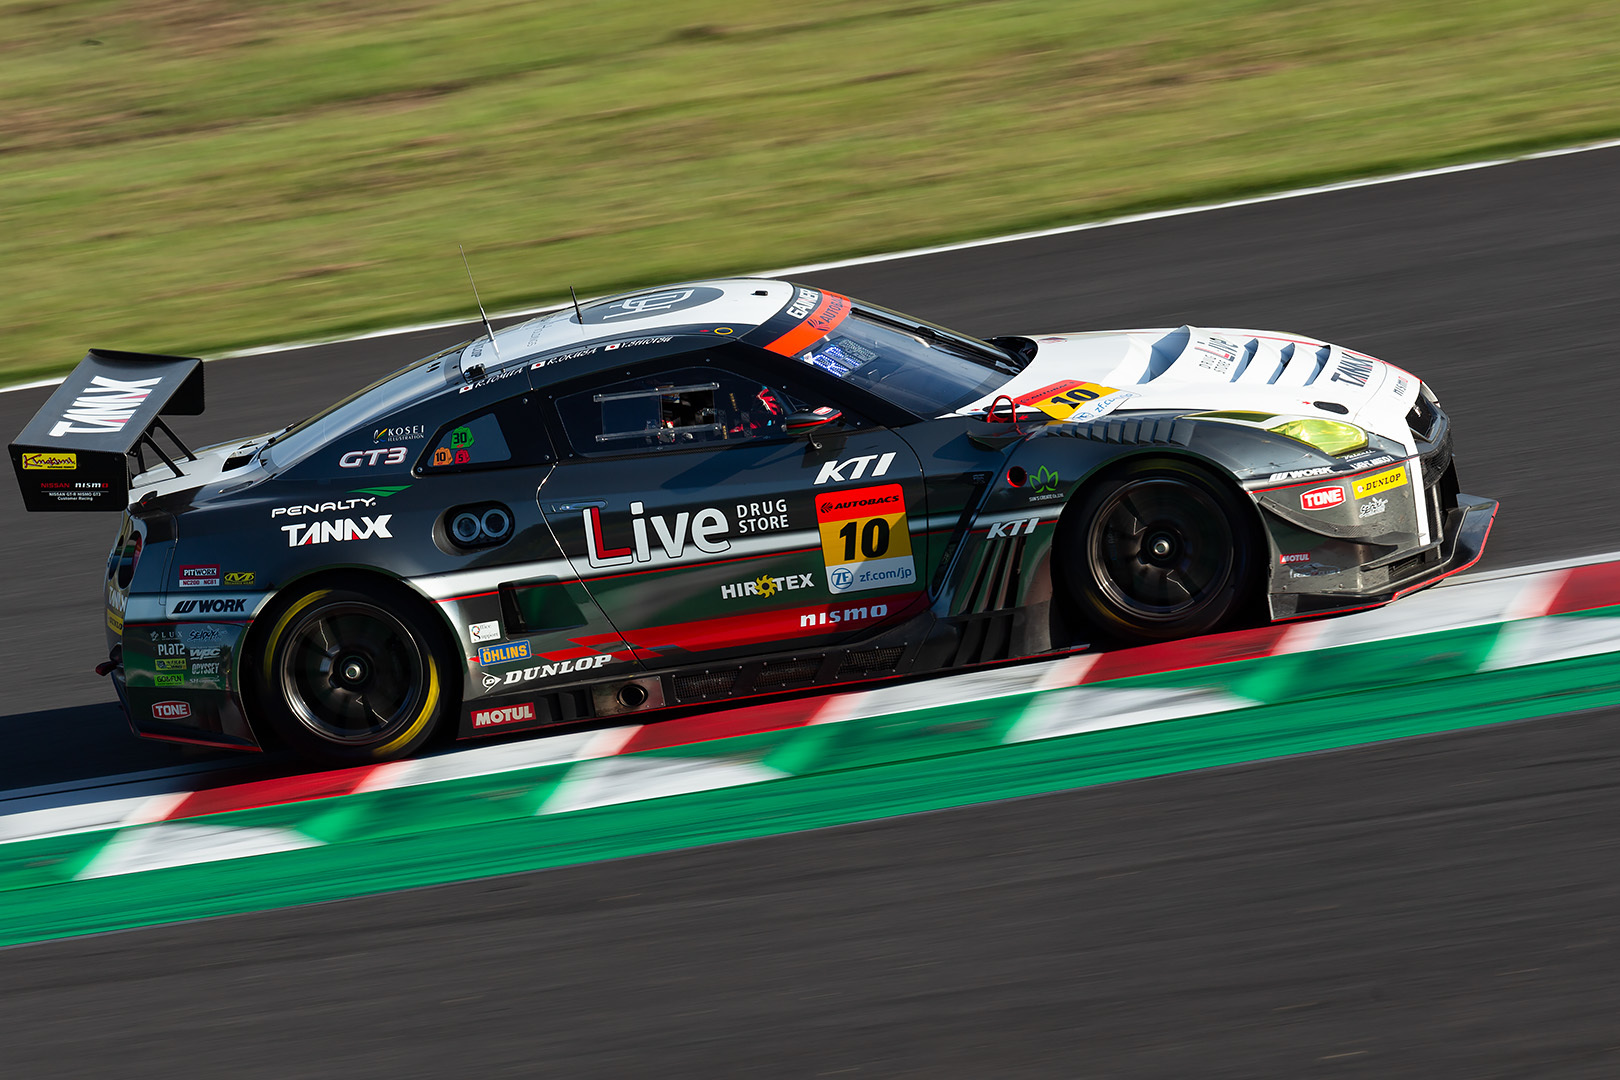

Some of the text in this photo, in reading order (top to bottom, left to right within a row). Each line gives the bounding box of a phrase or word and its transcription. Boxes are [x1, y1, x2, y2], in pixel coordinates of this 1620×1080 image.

[1050, 389, 1100, 410] 10
[388, 424, 425, 436] KOSEI
[388, 434, 425, 442] ILLUSTRATION
[452, 432, 468, 444] 30
[338, 446, 408, 468] GT3
[435, 452, 446, 462] 10
[458, 454, 464, 462] 5
[813, 452, 897, 485] KTI
[1290, 466, 1336, 478] WORK
[1366, 473, 1402, 490] DUNLOP
[834, 495, 900, 510] AUTOBACS
[1304, 488, 1342, 508] TONE
[271, 497, 375, 518] PENALTY
[736, 499, 787, 518] DRUG
[280, 514, 393, 548] TANAX
[738, 516, 790, 534] STORE
[986, 518, 1040, 539] KTI
[583, 501, 732, 568] Live
[840, 518, 890, 562] 10
[1281, 554, 1310, 562] MOTUL
[860, 567, 912, 582] zf.com/jp
[199, 599, 248, 613] WORK
[483, 645, 528, 663] ÖHLINS
[192, 662, 220, 674] ODYSSEY
[503, 654, 612, 684] DUNLOP
[156, 704, 188, 716] TONE
[476, 706, 532, 726] MOTUL
